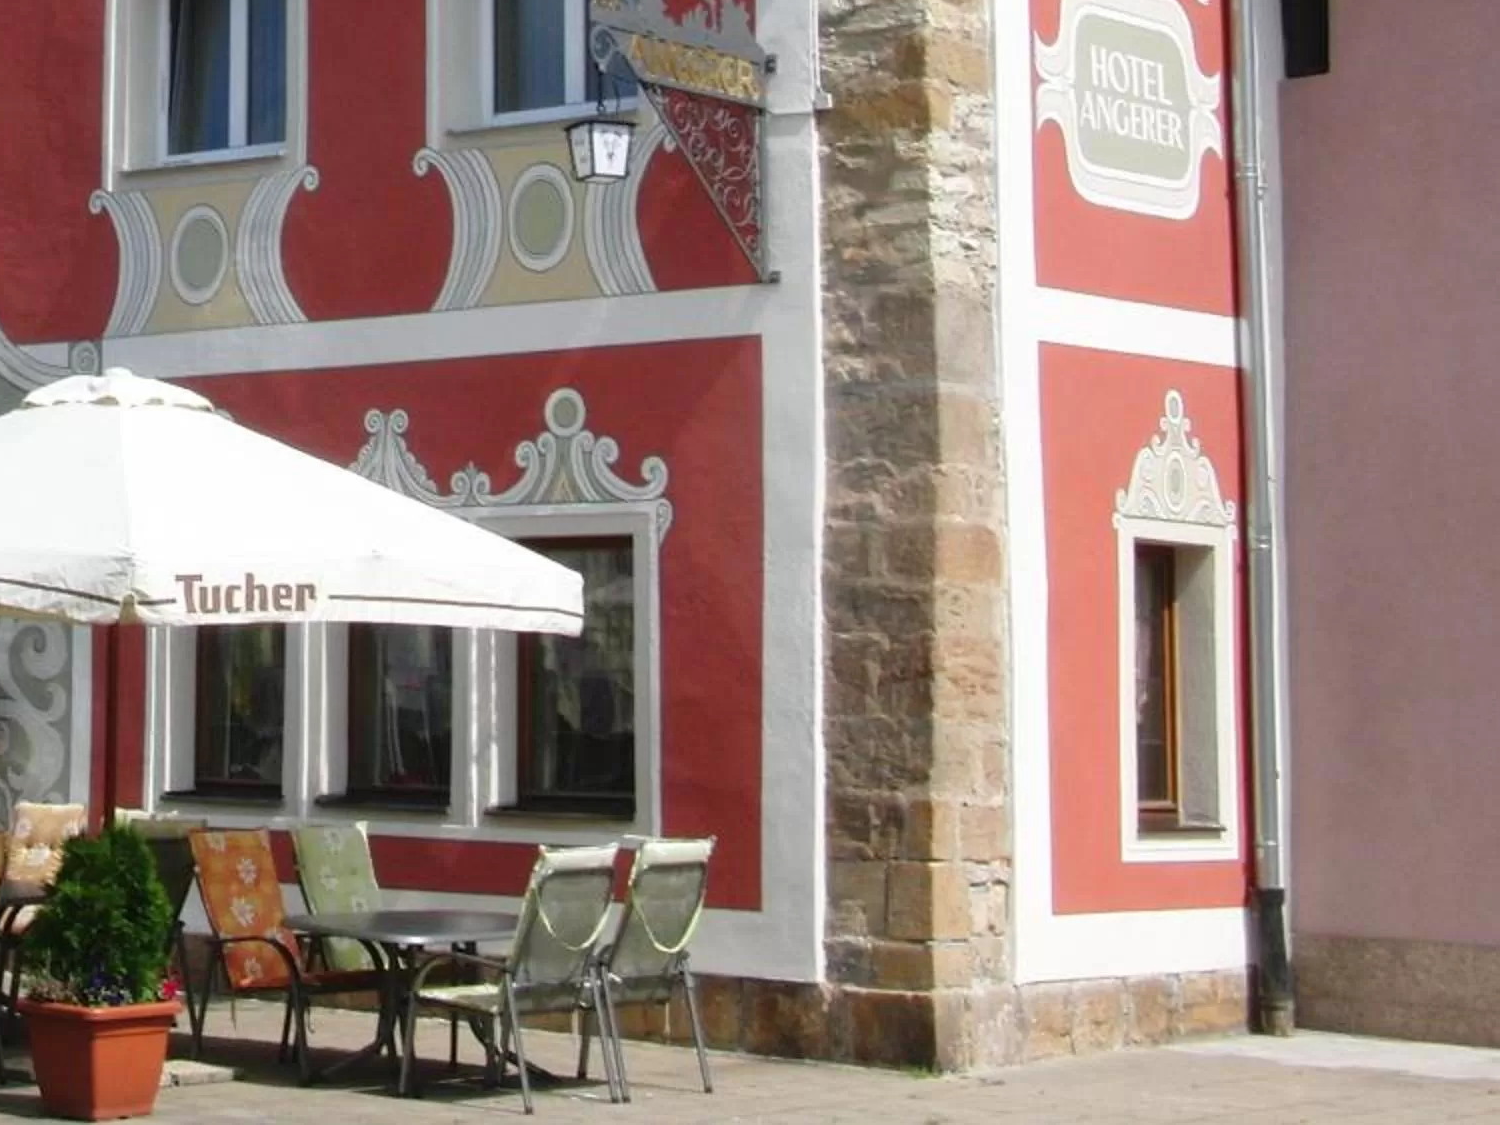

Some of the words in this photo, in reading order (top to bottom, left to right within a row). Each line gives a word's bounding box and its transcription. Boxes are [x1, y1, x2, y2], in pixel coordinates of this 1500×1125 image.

[1089, 43, 1173, 106] HOTEL
[1079, 89, 1186, 154] ANGERER
[174, 572, 317, 615] Tucher
